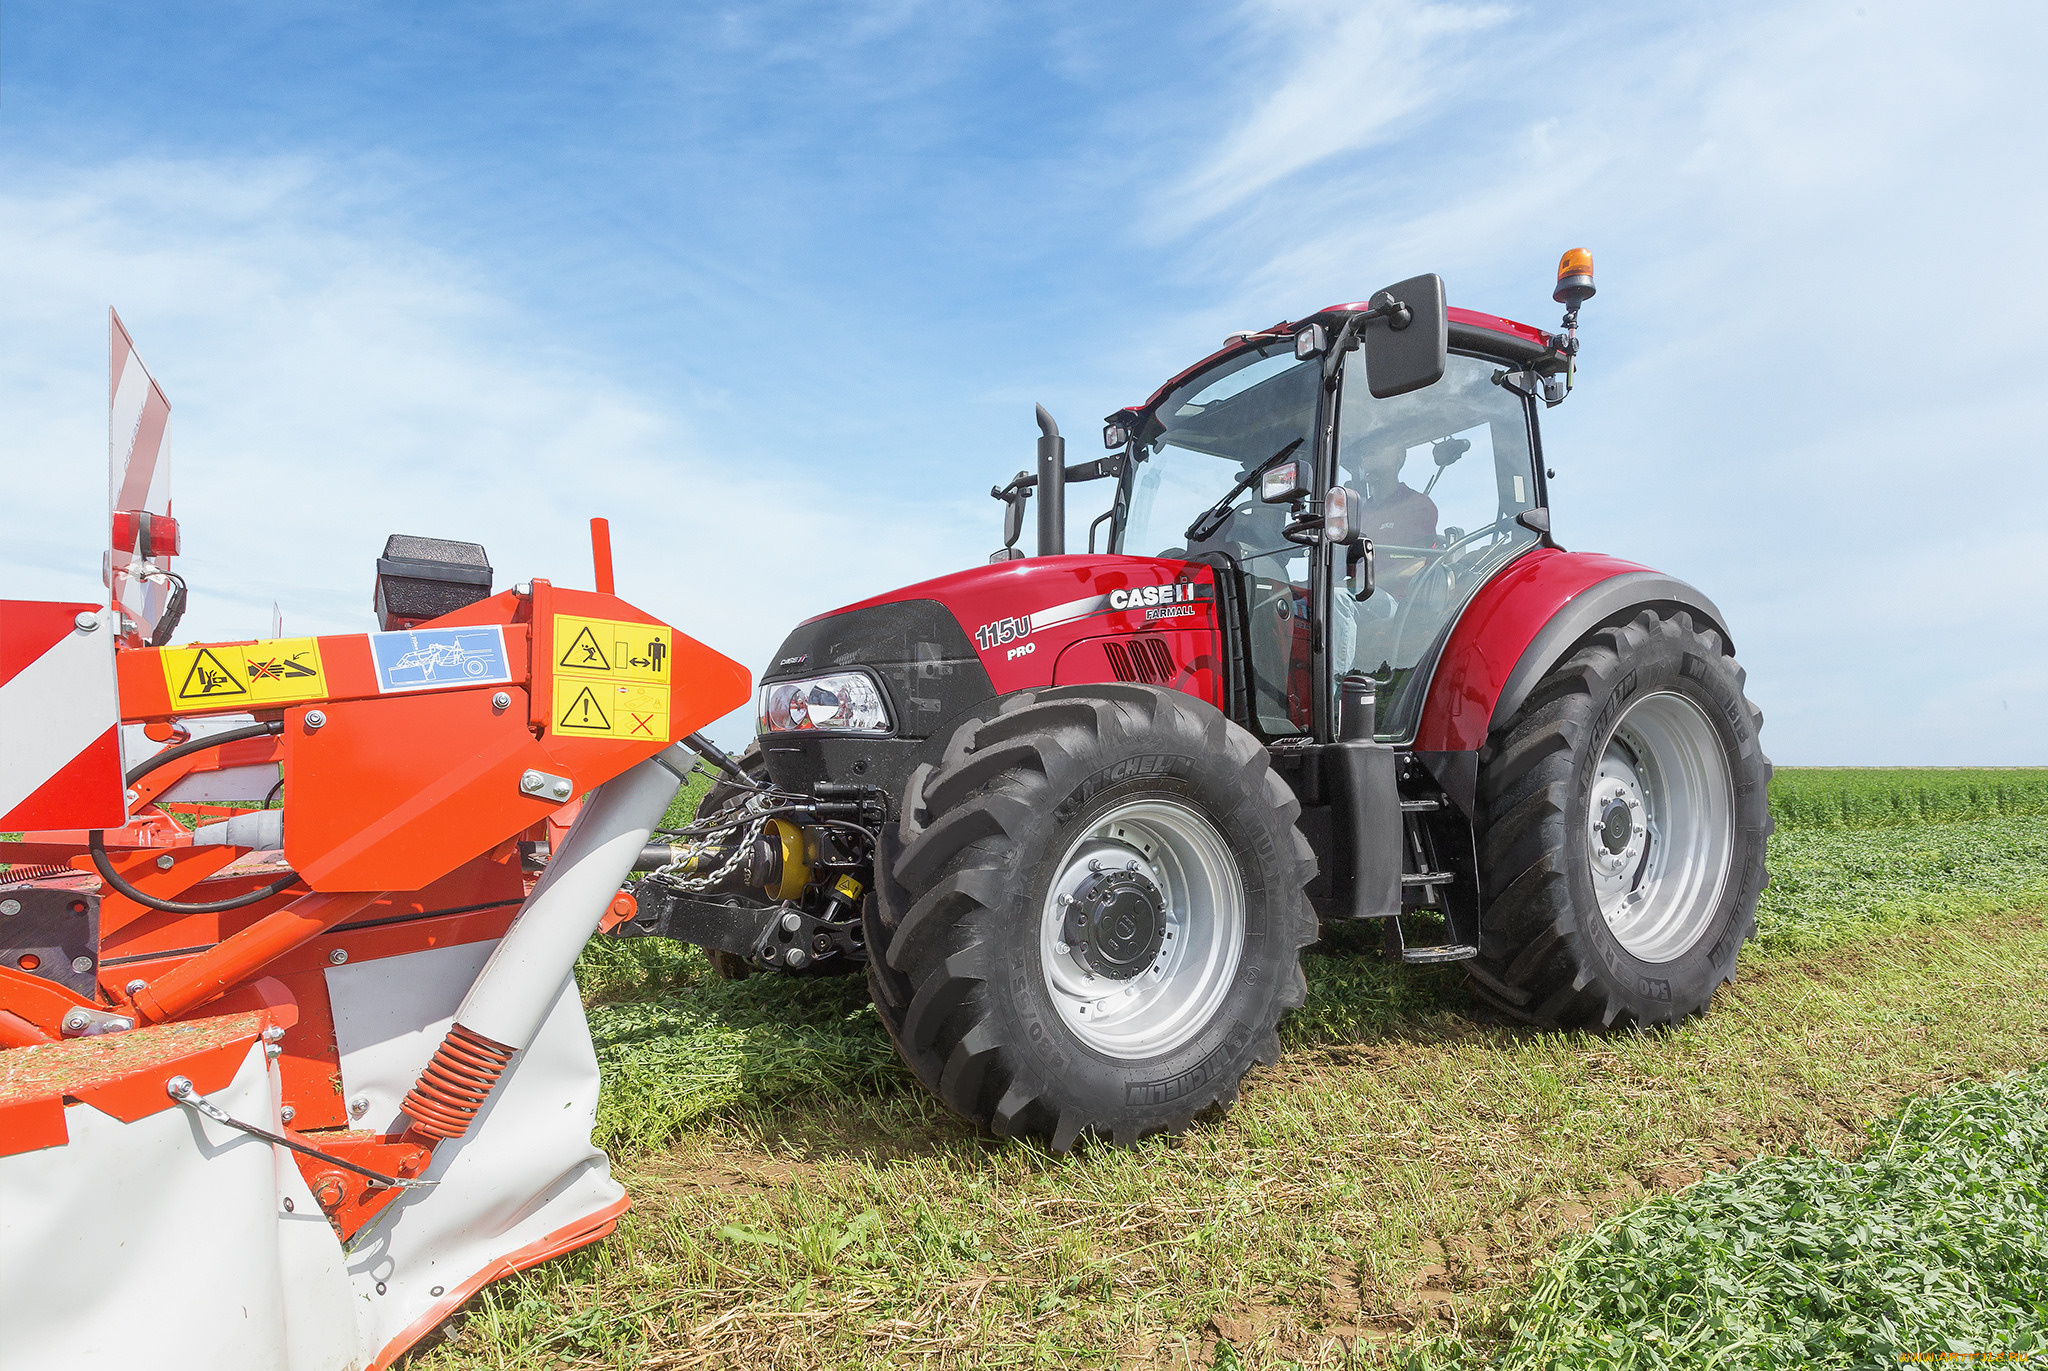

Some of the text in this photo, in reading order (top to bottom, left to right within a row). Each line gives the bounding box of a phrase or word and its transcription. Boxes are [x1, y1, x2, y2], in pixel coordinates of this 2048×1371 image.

[1110, 586, 1174, 609] CASE
[1145, 605, 1196, 620] FARMALL
[975, 614, 1031, 650] 115U
[1007, 642, 1036, 661] PRO
[1126, 1045, 1232, 1105] MICHELIN
